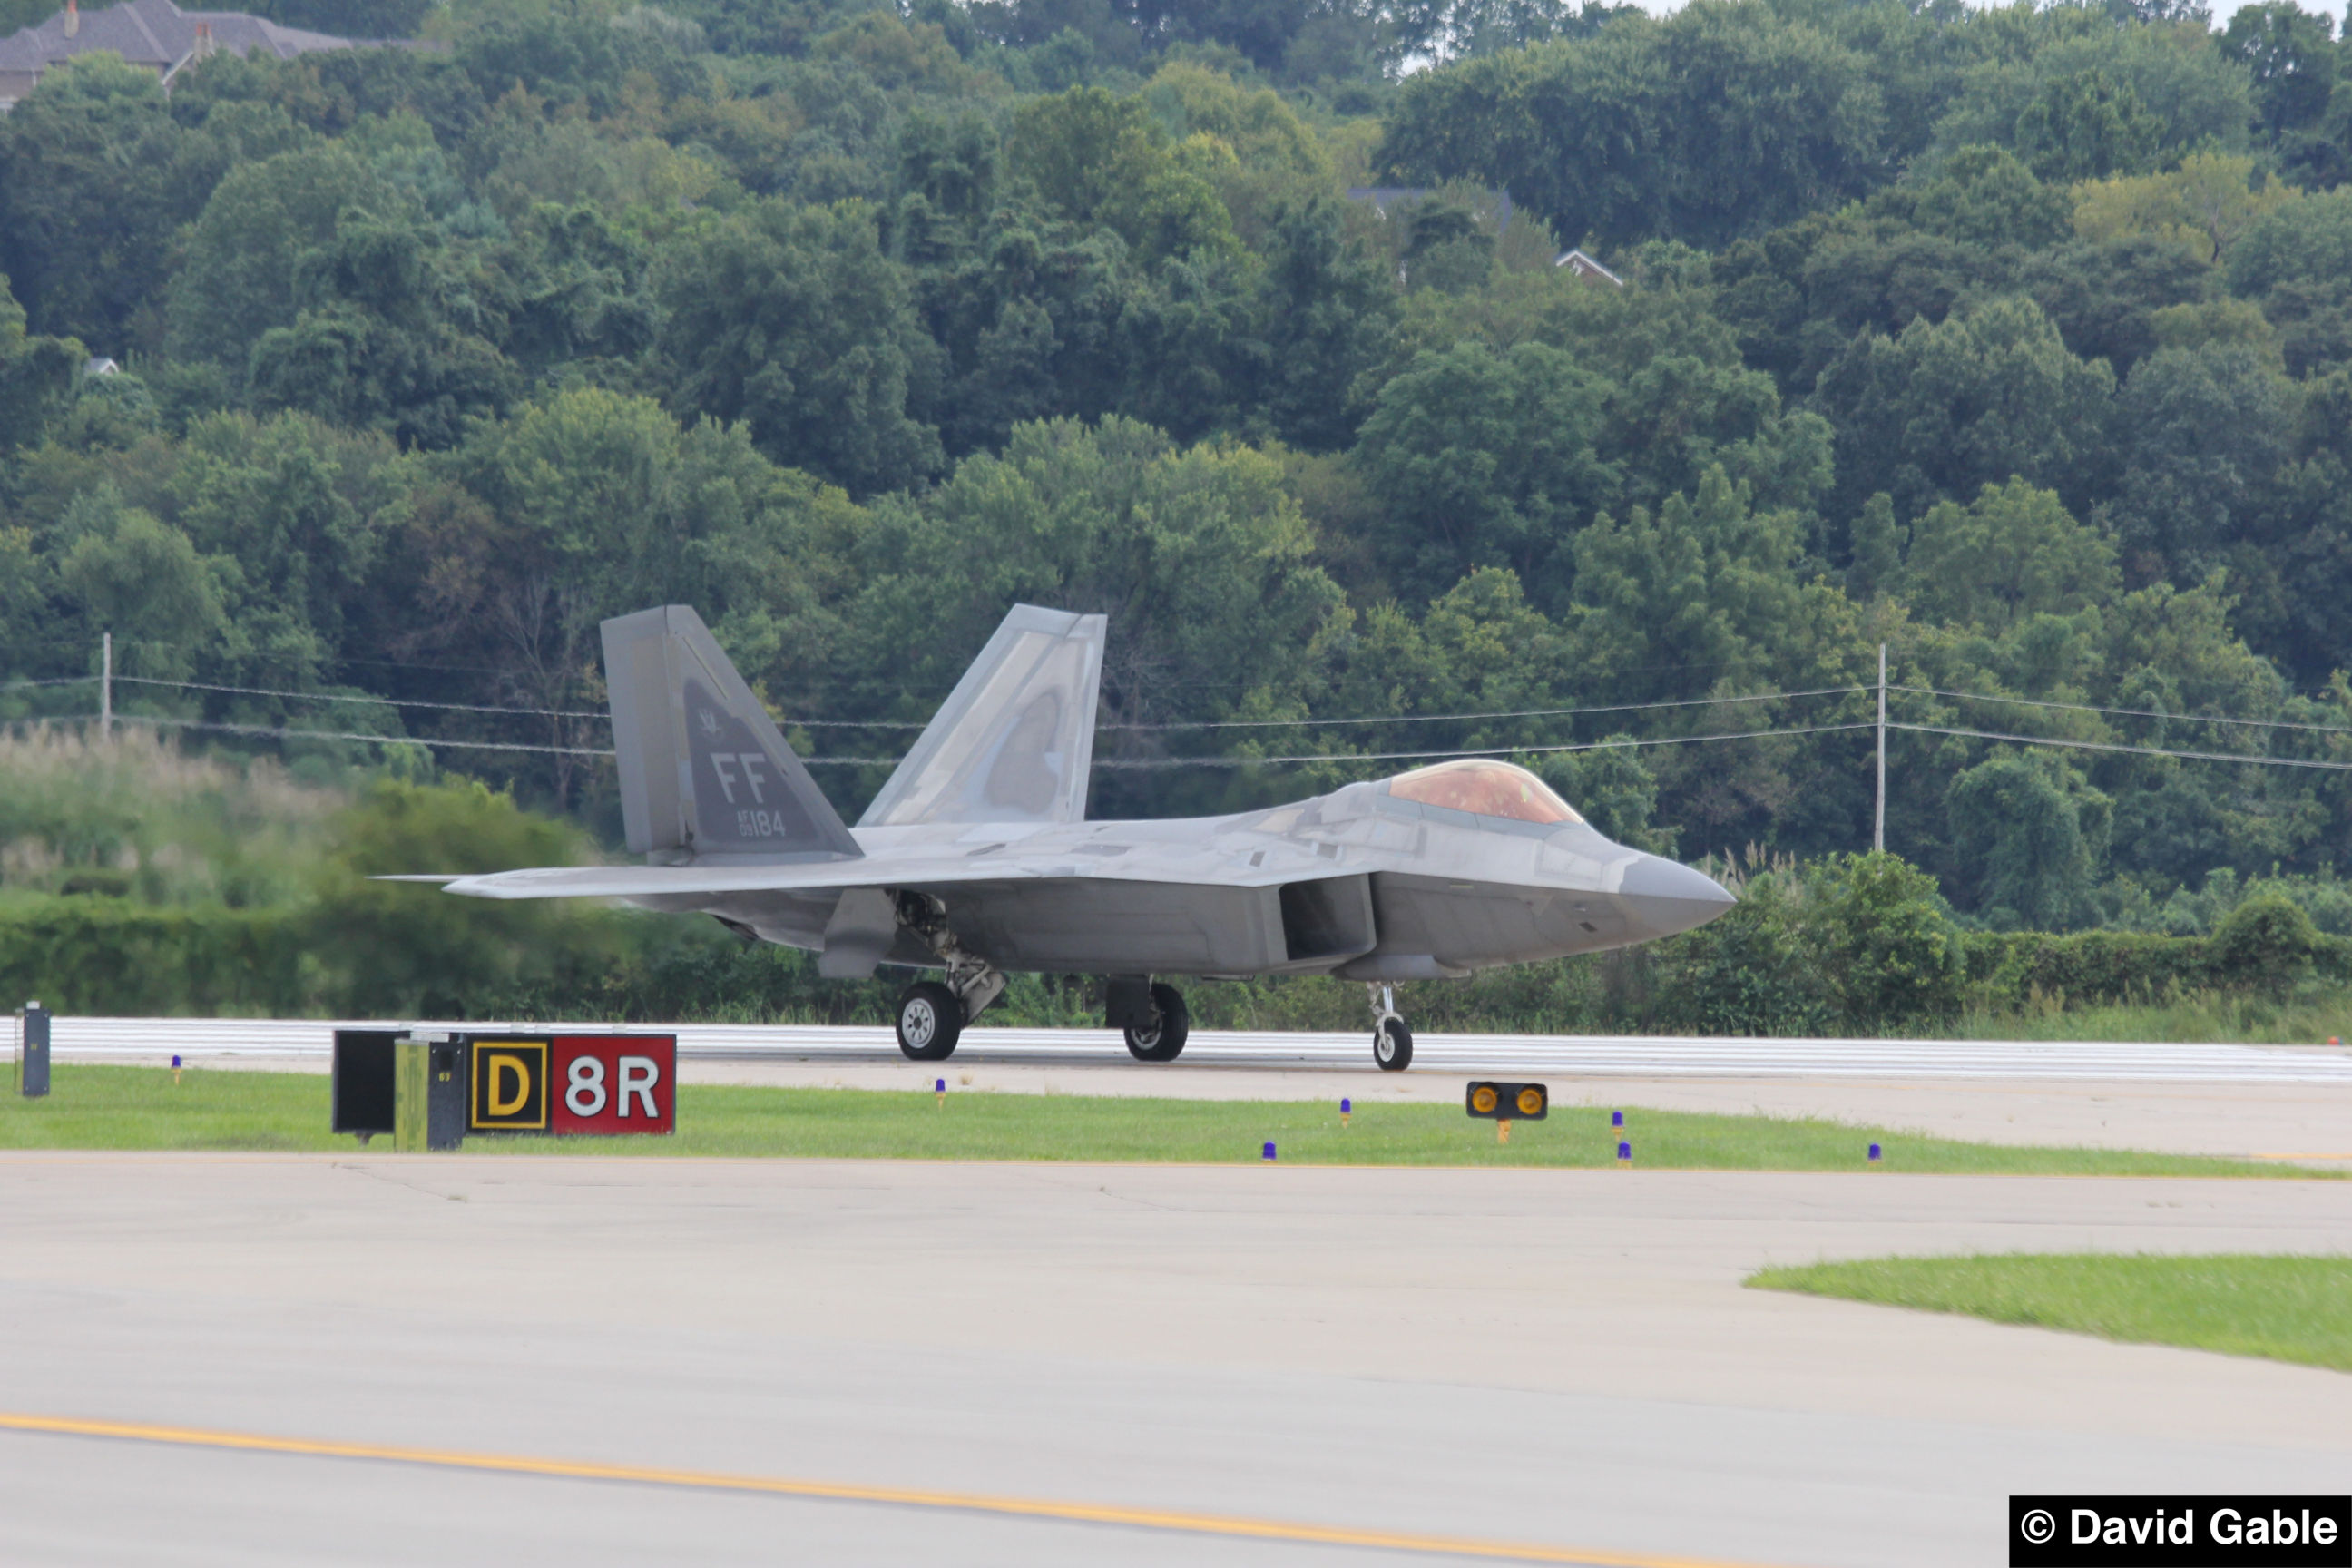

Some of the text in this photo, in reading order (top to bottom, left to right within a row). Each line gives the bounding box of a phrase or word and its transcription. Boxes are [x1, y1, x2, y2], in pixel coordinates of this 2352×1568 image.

[710, 752, 766, 804] FF
[750, 809, 786, 837] 184
[488, 1054, 530, 1116] D
[564, 1055, 660, 1118] 8R
